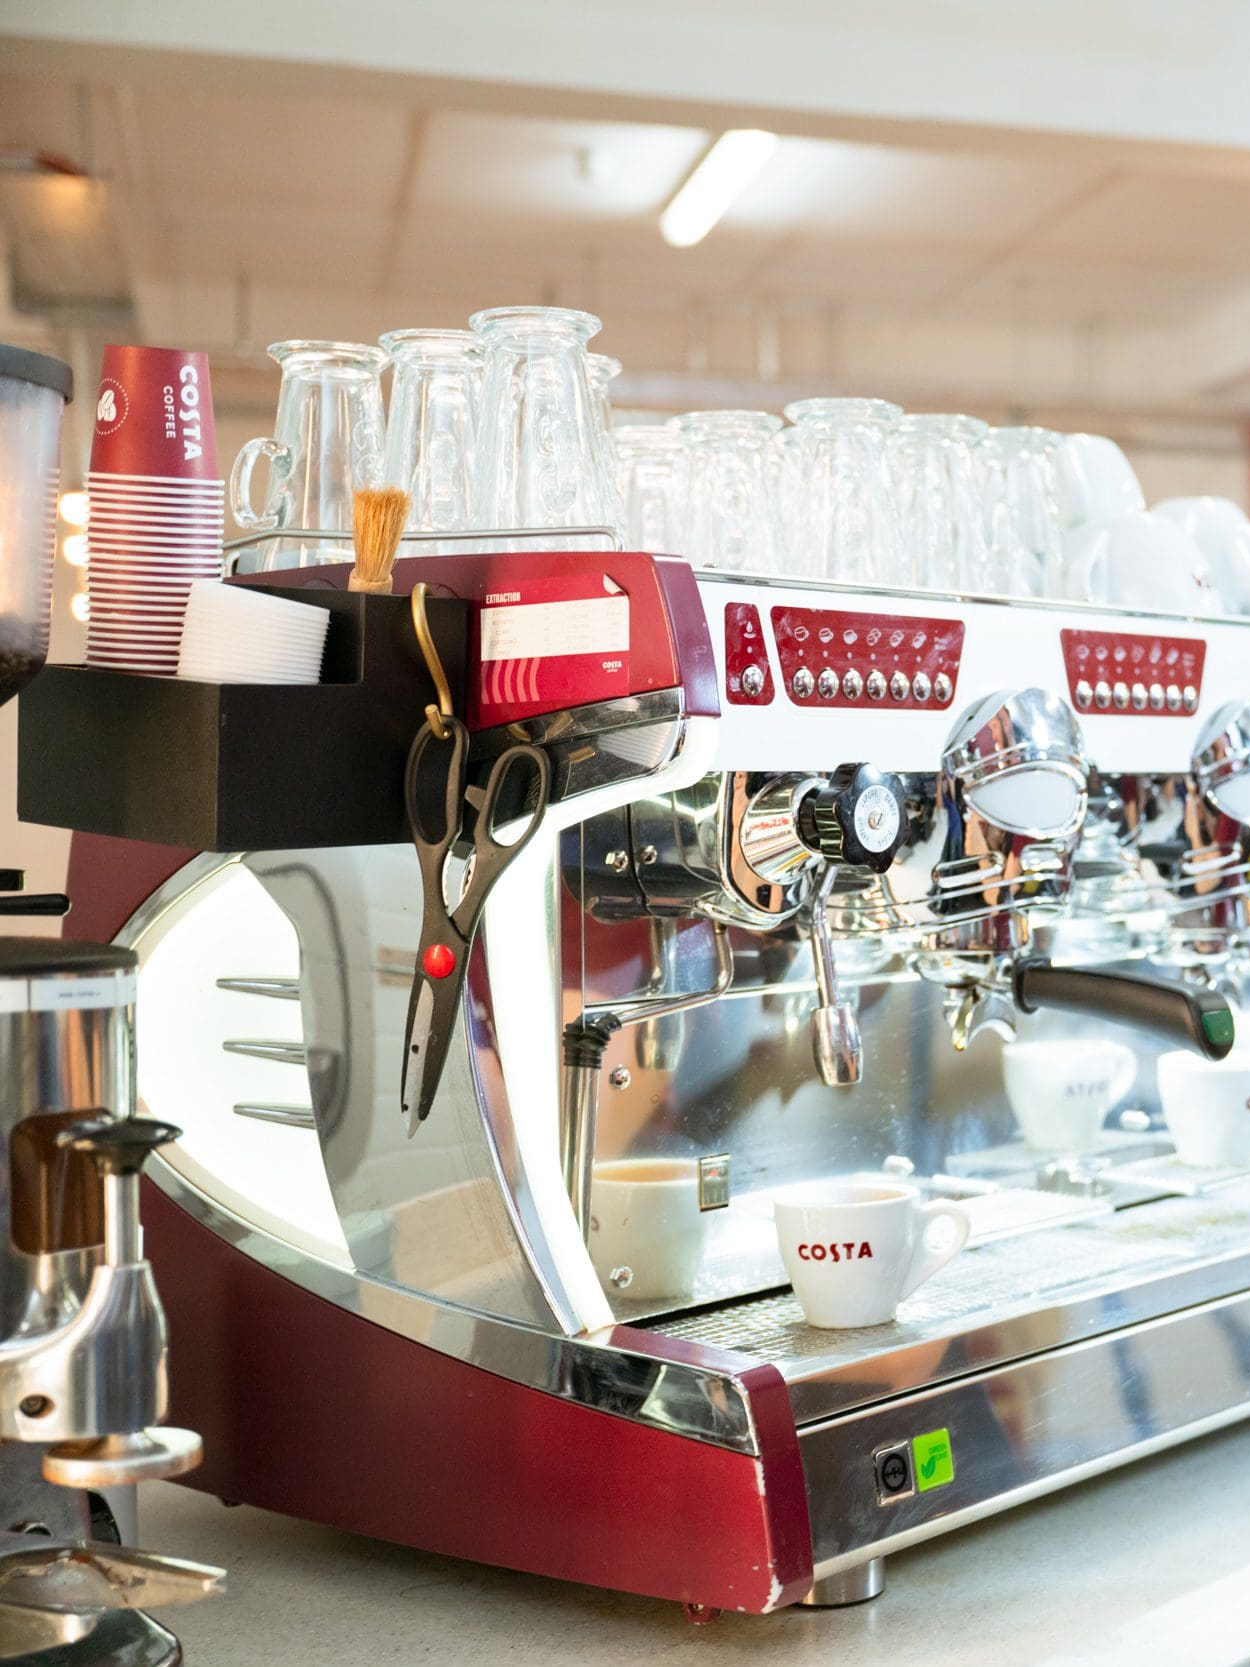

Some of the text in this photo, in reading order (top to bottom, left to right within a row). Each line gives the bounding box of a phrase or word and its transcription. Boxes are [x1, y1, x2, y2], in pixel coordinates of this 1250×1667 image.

[163, 385, 176, 439] COFFEE
[179, 365, 202, 461] COSTA
[485, 592, 521, 604] EXTRACTION
[602, 660, 623, 669] COSTA
[797, 1241, 873, 1263] COSTA
